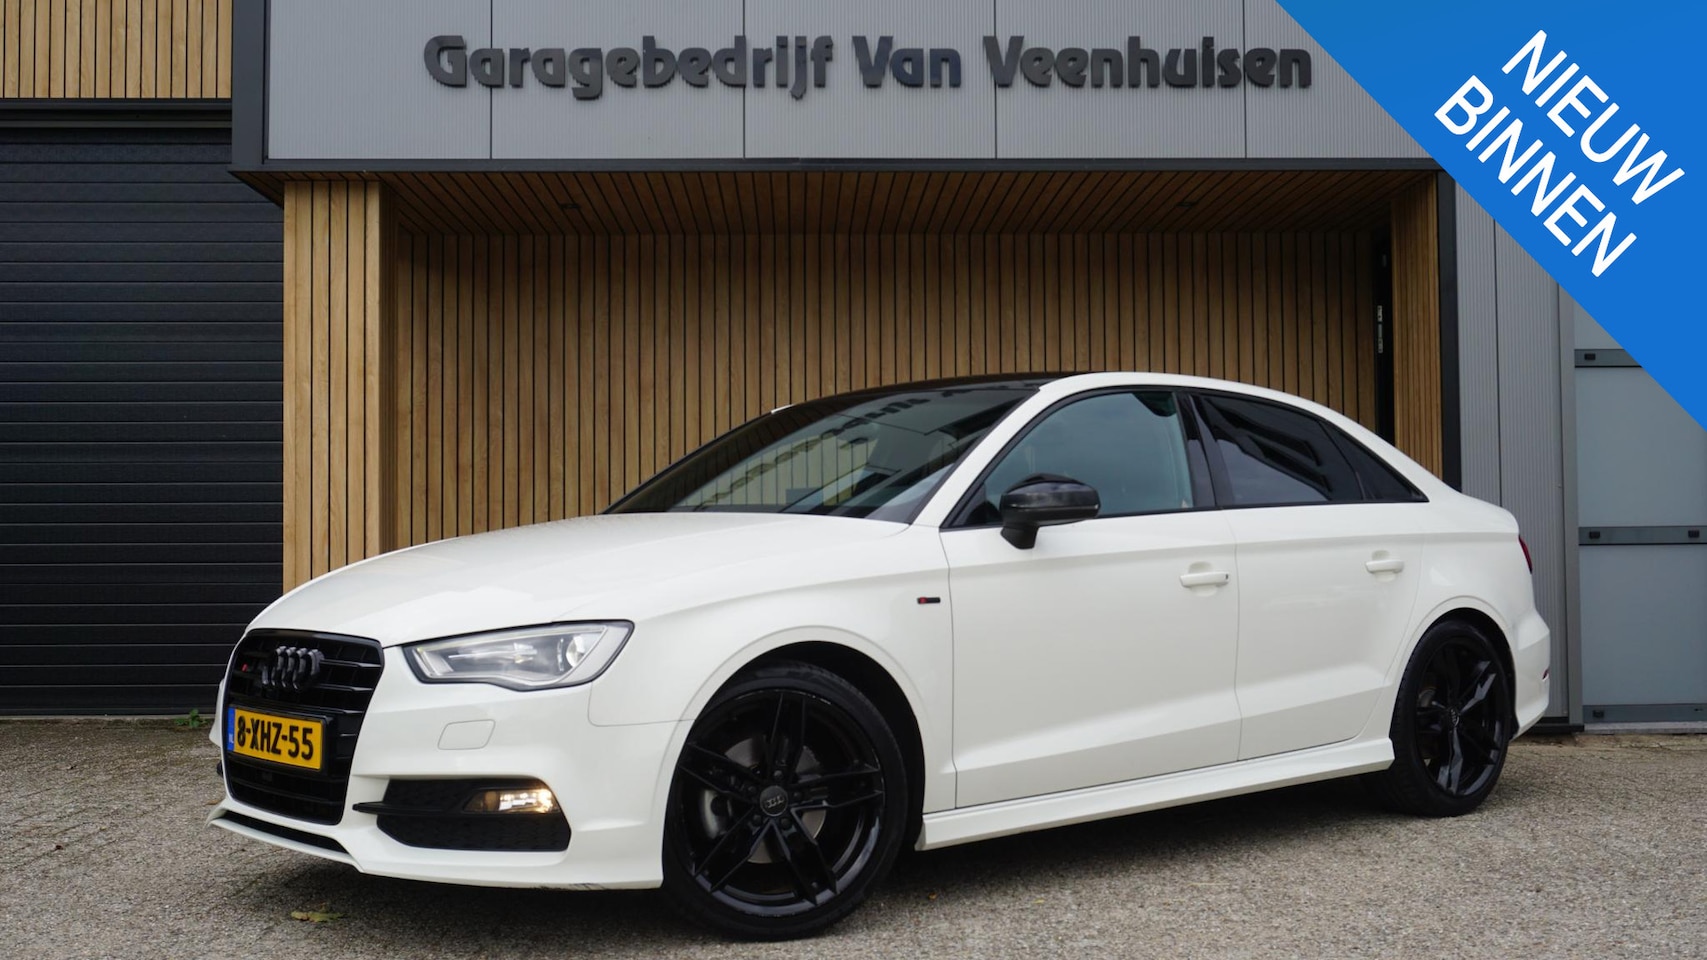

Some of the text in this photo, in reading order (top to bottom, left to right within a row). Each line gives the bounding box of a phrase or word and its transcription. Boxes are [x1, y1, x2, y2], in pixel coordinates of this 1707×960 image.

[424, 35, 1312, 101] Garagebedrijf Van Veenhuisen
[237, 715, 314, 761] 8-XHZ-55
